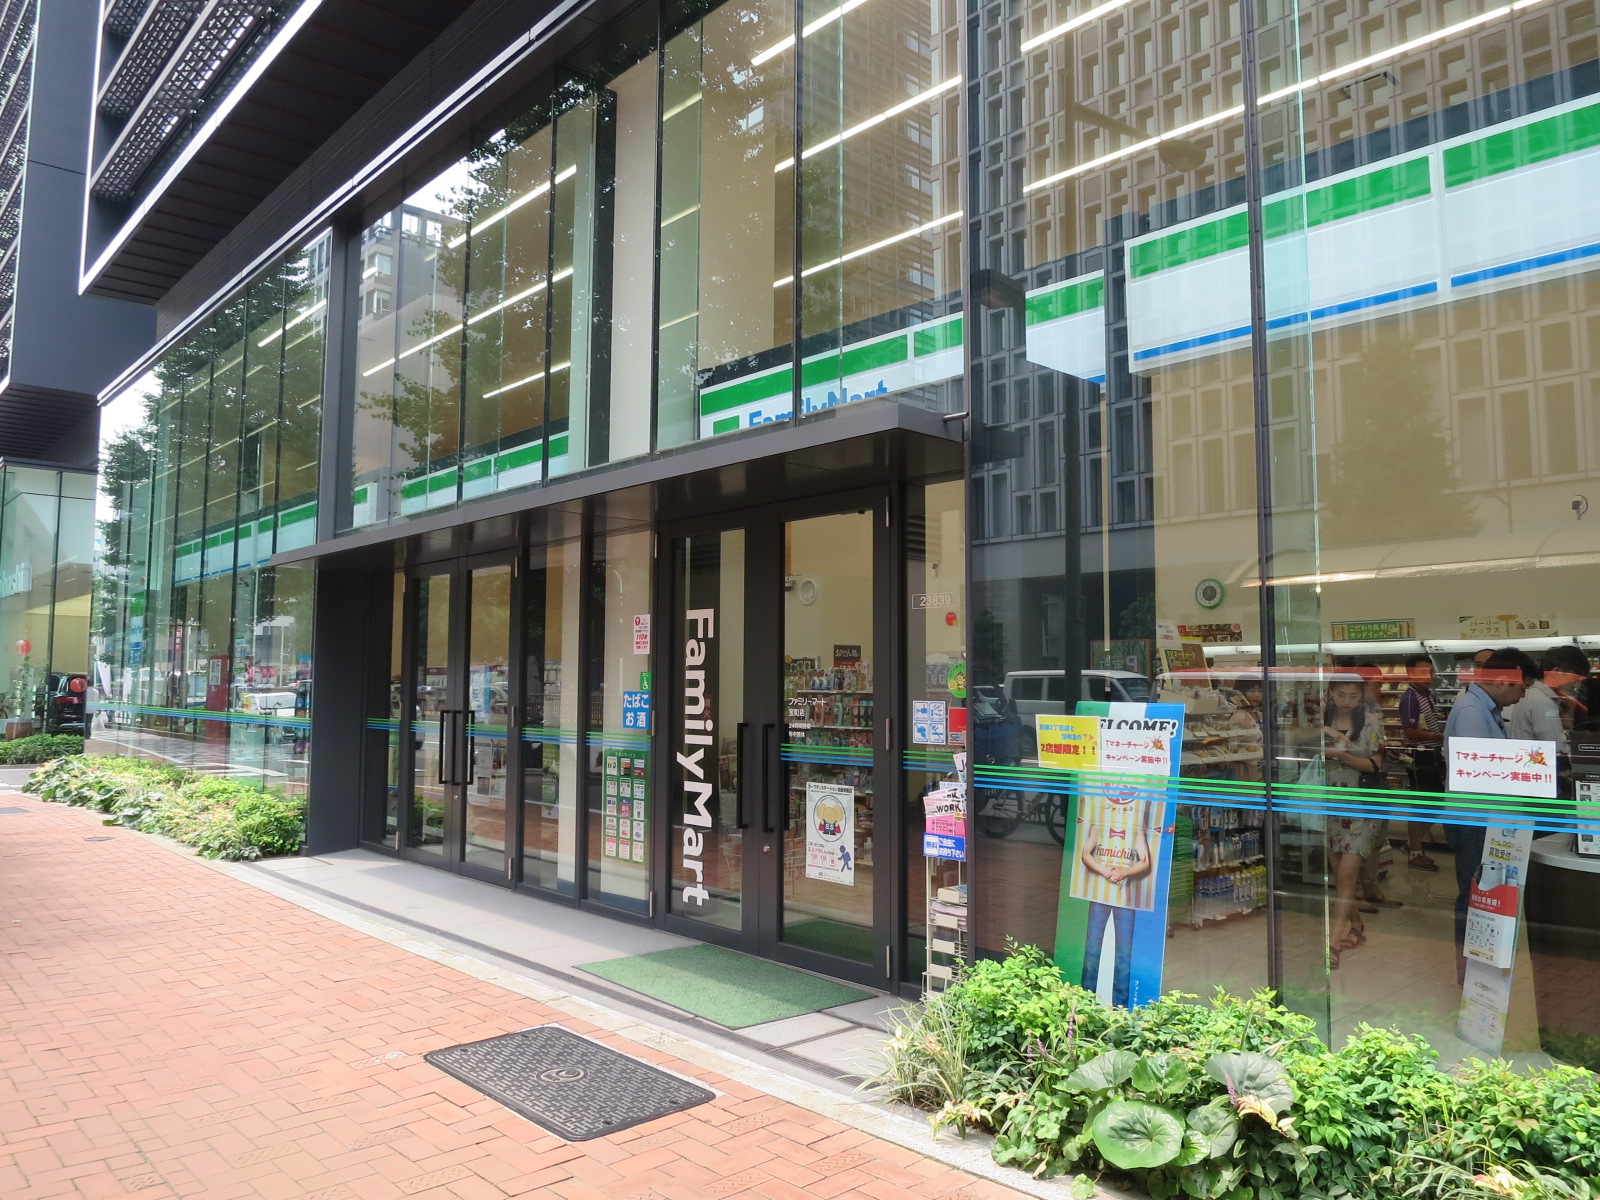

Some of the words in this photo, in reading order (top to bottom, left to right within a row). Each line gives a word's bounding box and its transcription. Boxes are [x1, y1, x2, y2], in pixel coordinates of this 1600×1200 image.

[749, 379, 888, 427] FamlyMart
[919, 595, 951, 607] 23839
[623, 693, 649, 708] たばこ
[788, 697, 827, 707] ファミリーマート
[625, 711, 647, 728] お酒
[1105, 739, 1150, 749] Tマネーチャージ
[677, 608, 714, 906] FamilyMart
[1455, 751, 1524, 764] Tマネーチャージ
